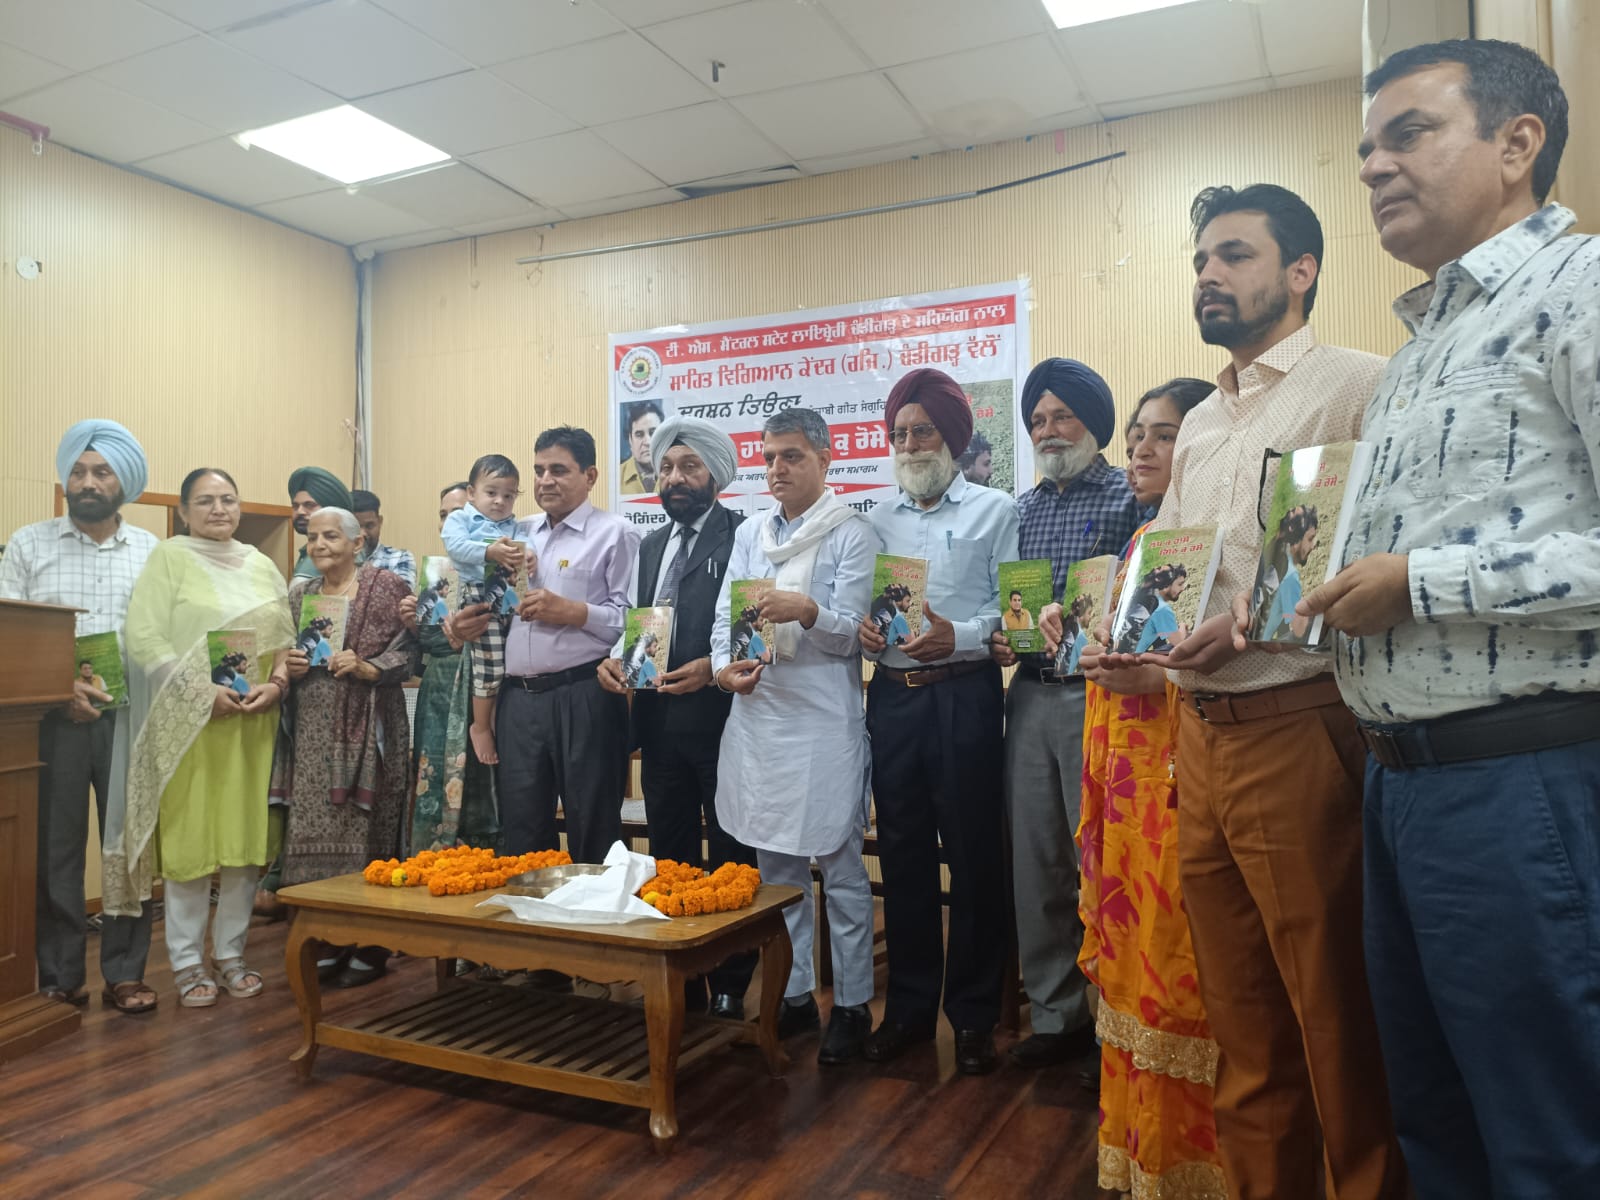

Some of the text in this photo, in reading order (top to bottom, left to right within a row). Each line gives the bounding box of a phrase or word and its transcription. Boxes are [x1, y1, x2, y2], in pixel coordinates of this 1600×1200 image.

[762, 330, 788, 347] ਸਟੇਟ
[902, 314, 912, 328] ਦੇ
[973, 303, 1006, 320] ਨਾਲ
[669, 368, 712, 391] ਸਾਹਿਤ
[718, 362, 793, 387] ਵਿਗਿਆਨ
[798, 356, 836, 378] ਕੇਂਦਰ
[898, 341, 960, 367] ਚੰਡੀਗੜ੍ਹ
[967, 334, 1001, 358] ਵੱਲੋਂ
[837, 402, 858, 414] ਗੀਤ
[834, 433, 850, 457] ਕੁ
[854, 425, 886, 450] ਰੋਸੇ
